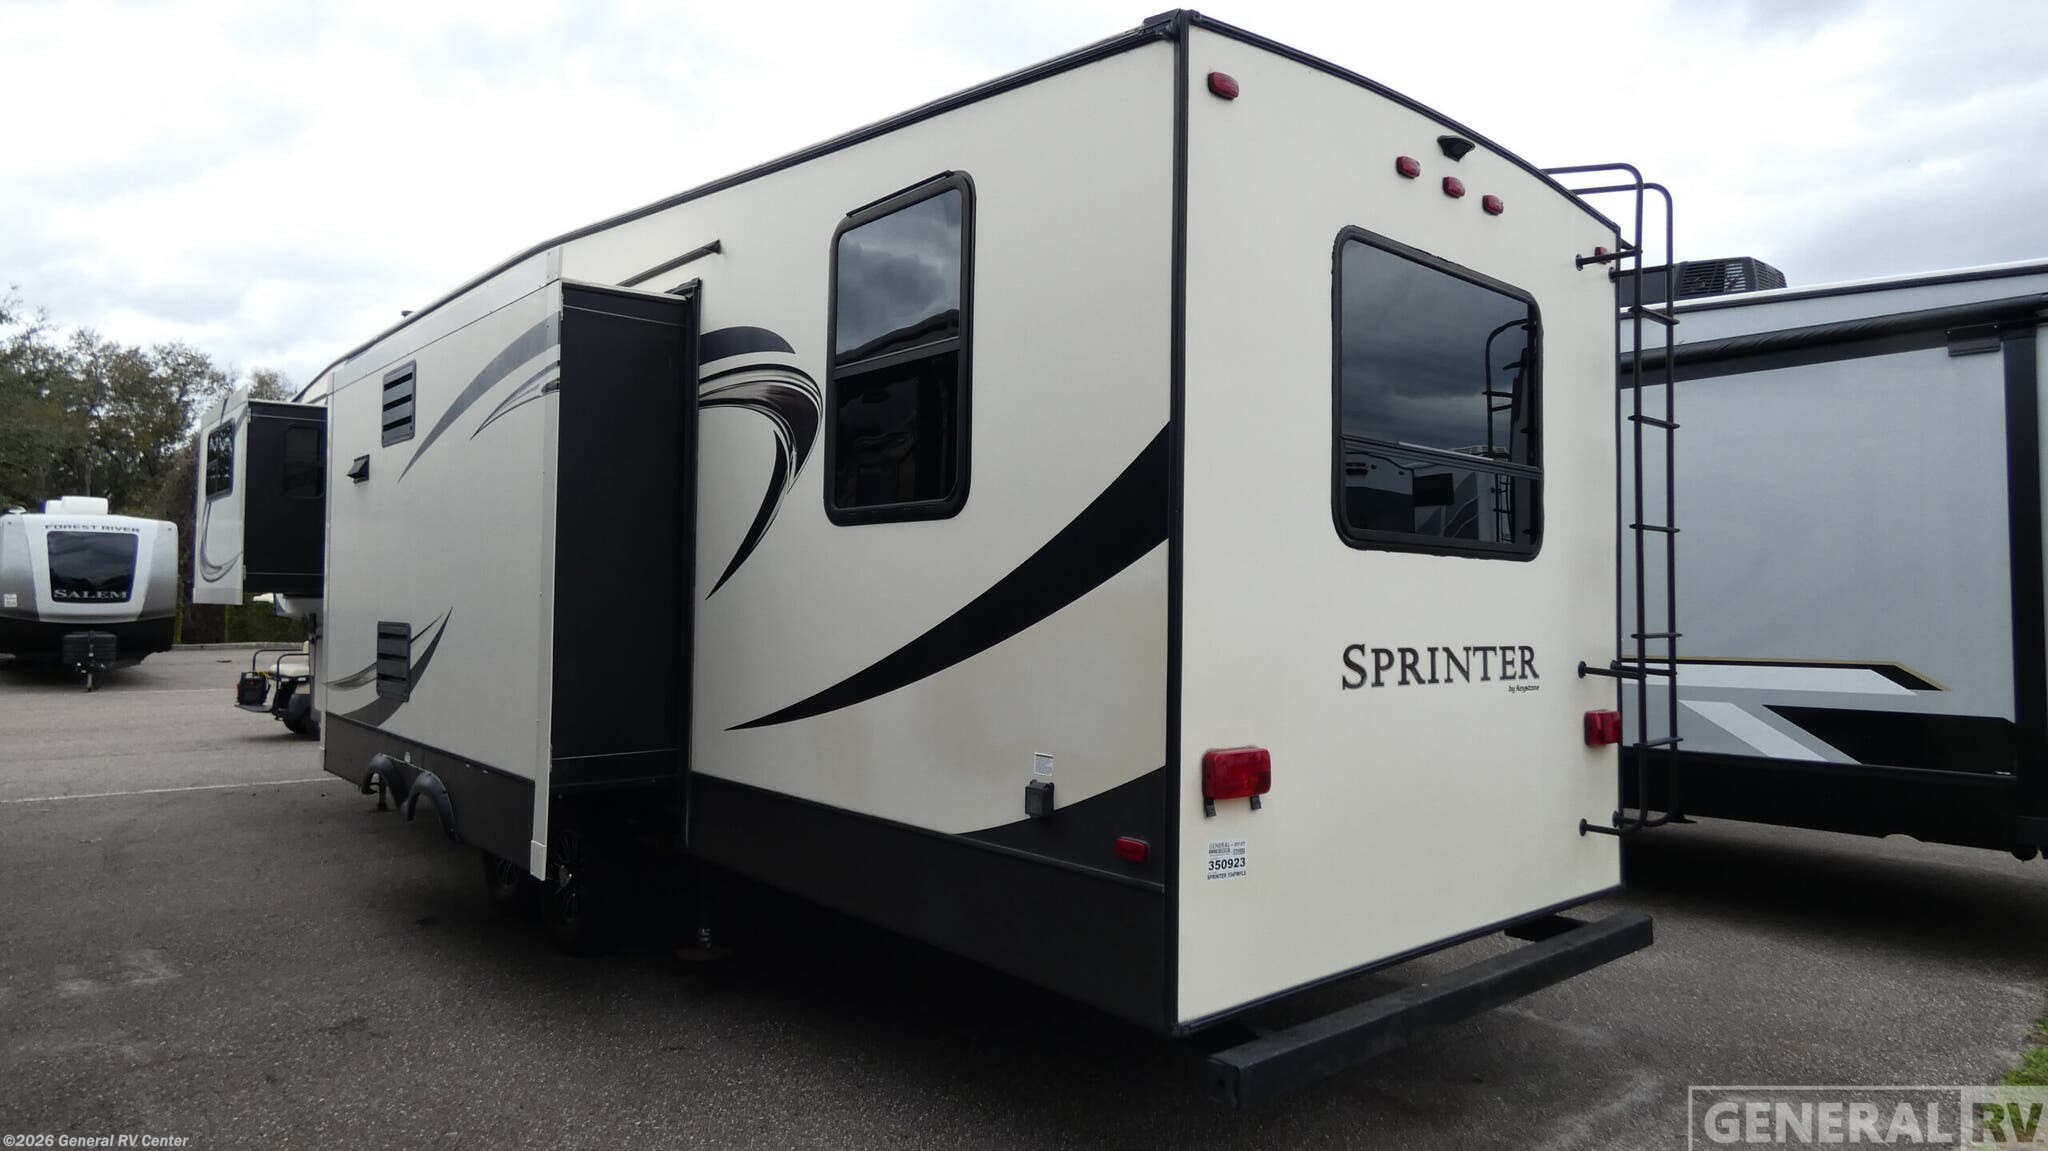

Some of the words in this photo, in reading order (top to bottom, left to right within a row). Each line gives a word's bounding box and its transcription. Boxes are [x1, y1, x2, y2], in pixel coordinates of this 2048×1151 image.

[53, 589, 127, 599] SALEM
[1342, 643, 1540, 690] SPRINTER
[1508, 685, 1515, 693] by
[1208, 857, 1246, 871] 350923
